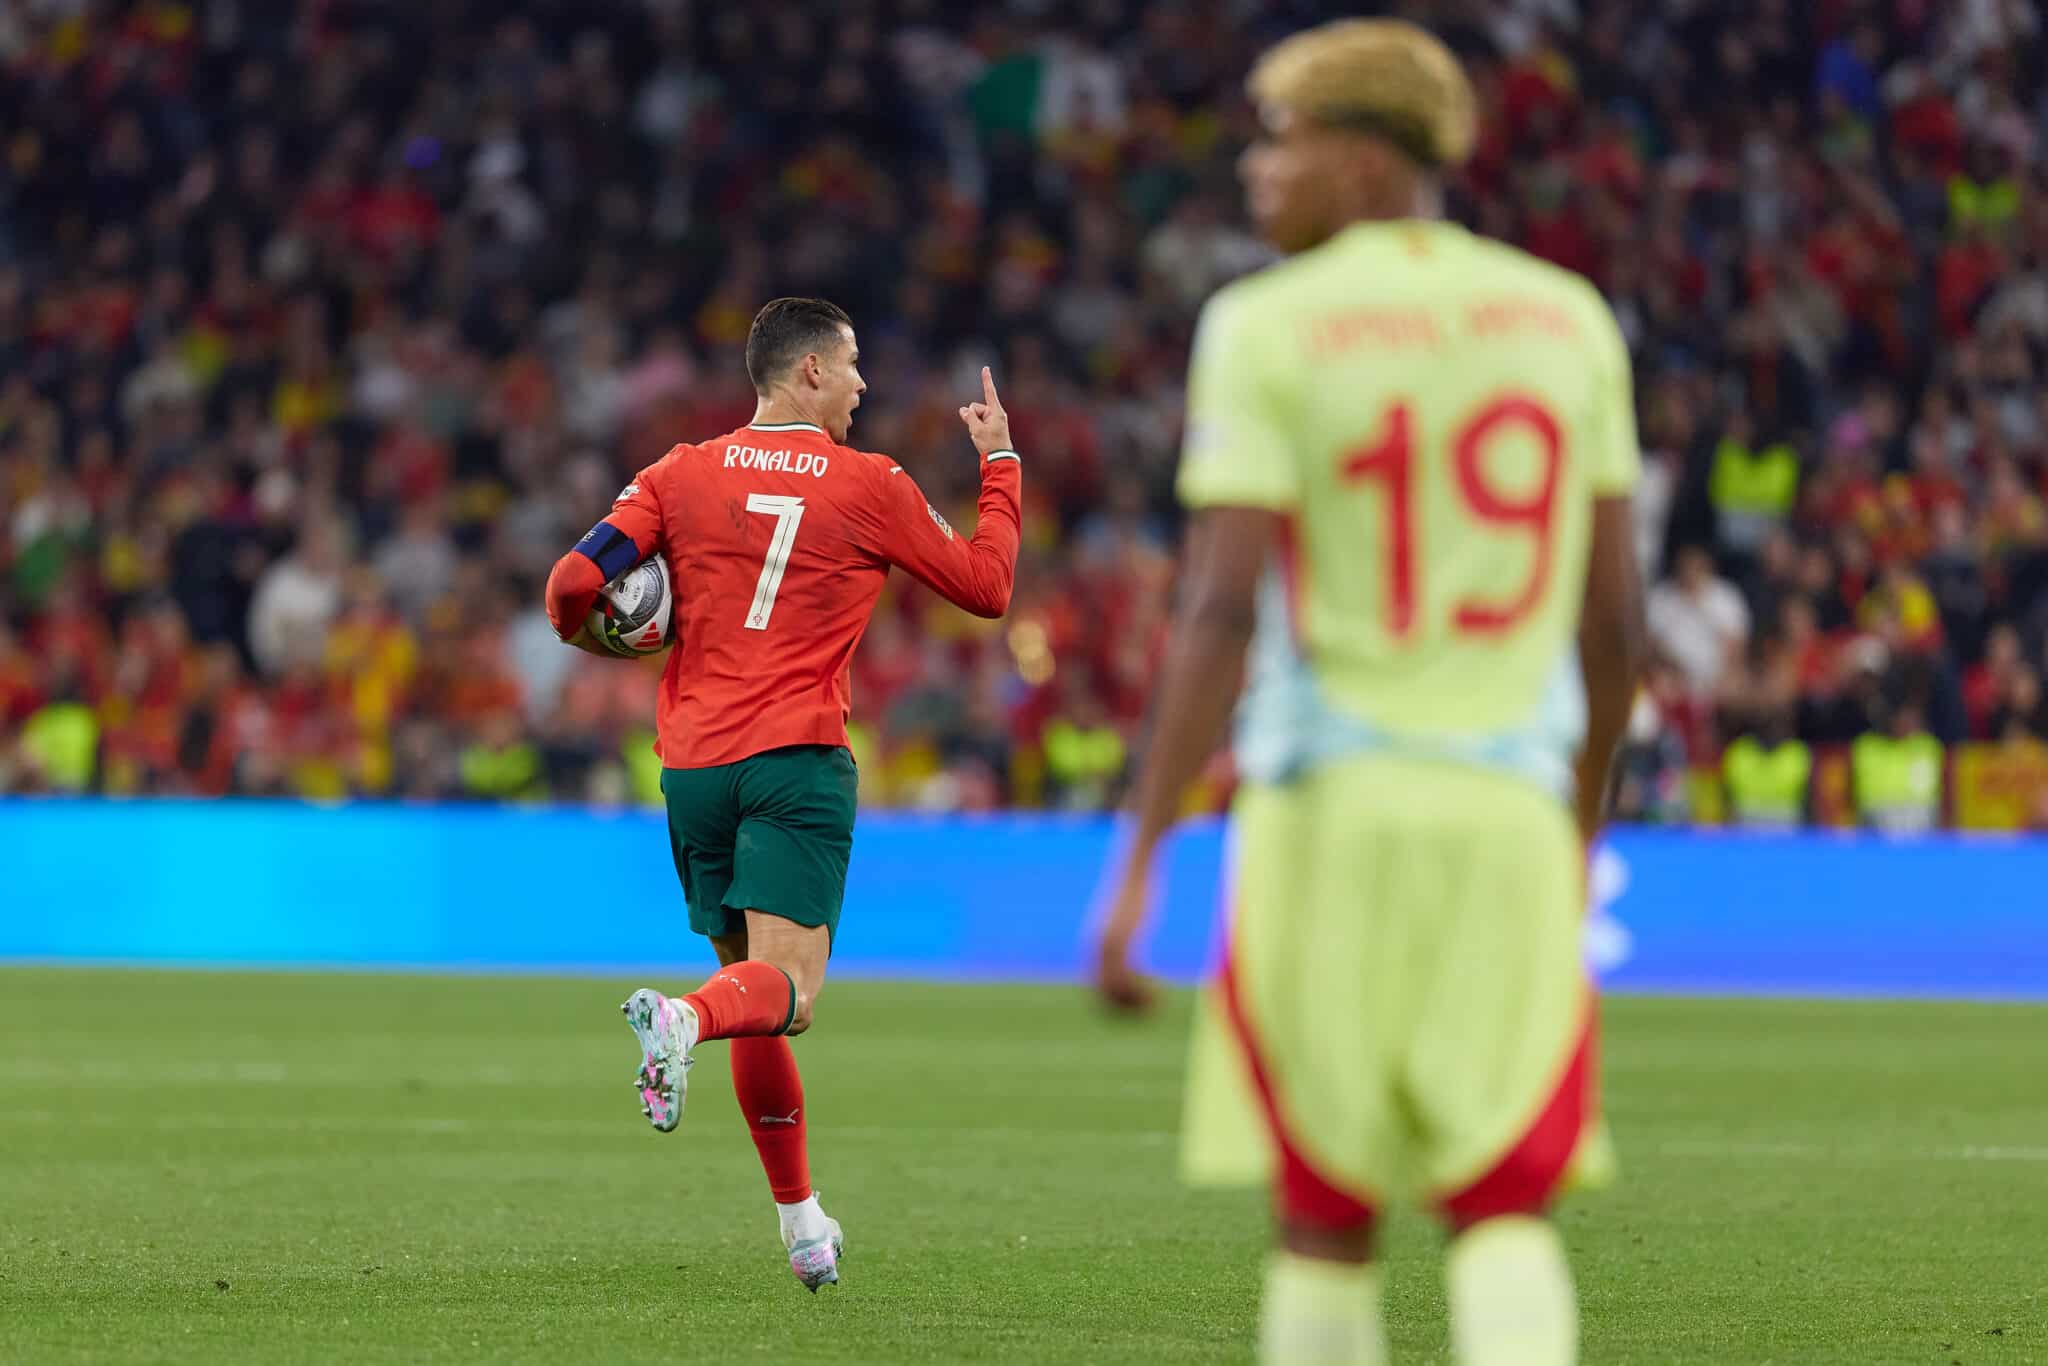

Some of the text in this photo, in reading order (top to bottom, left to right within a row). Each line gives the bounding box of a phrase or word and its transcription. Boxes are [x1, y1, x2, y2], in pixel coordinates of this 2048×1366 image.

[723, 444, 829, 478] RONALDO
[1338, 392, 1564, 639] 19
[743, 492, 806, 631] 7
